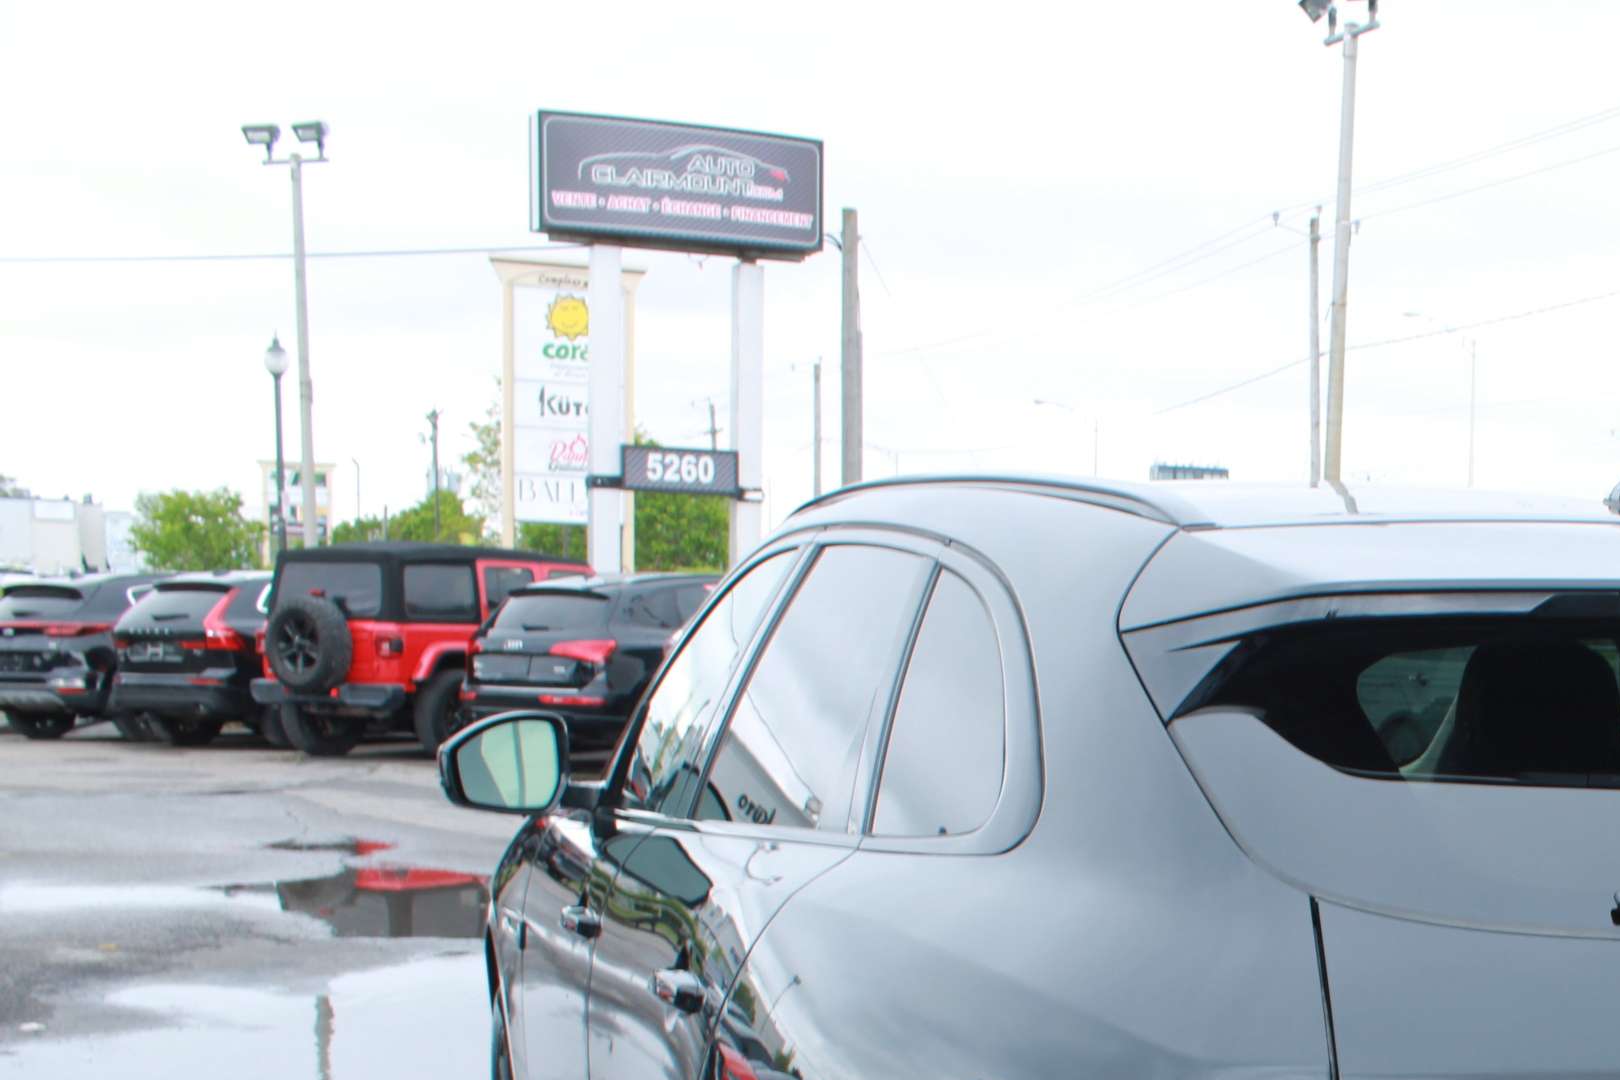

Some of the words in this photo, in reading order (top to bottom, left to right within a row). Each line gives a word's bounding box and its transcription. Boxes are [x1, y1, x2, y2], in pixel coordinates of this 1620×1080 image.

[591, 163, 754, 196] CLAIRMOUNT
[687, 154, 755, 178] AUTO
[552, 189, 597, 211] VENTE
[606, 194, 652, 213] ACHAT
[730, 205, 814, 231] FINANCEMENT
[646, 452, 715, 484] 5260
